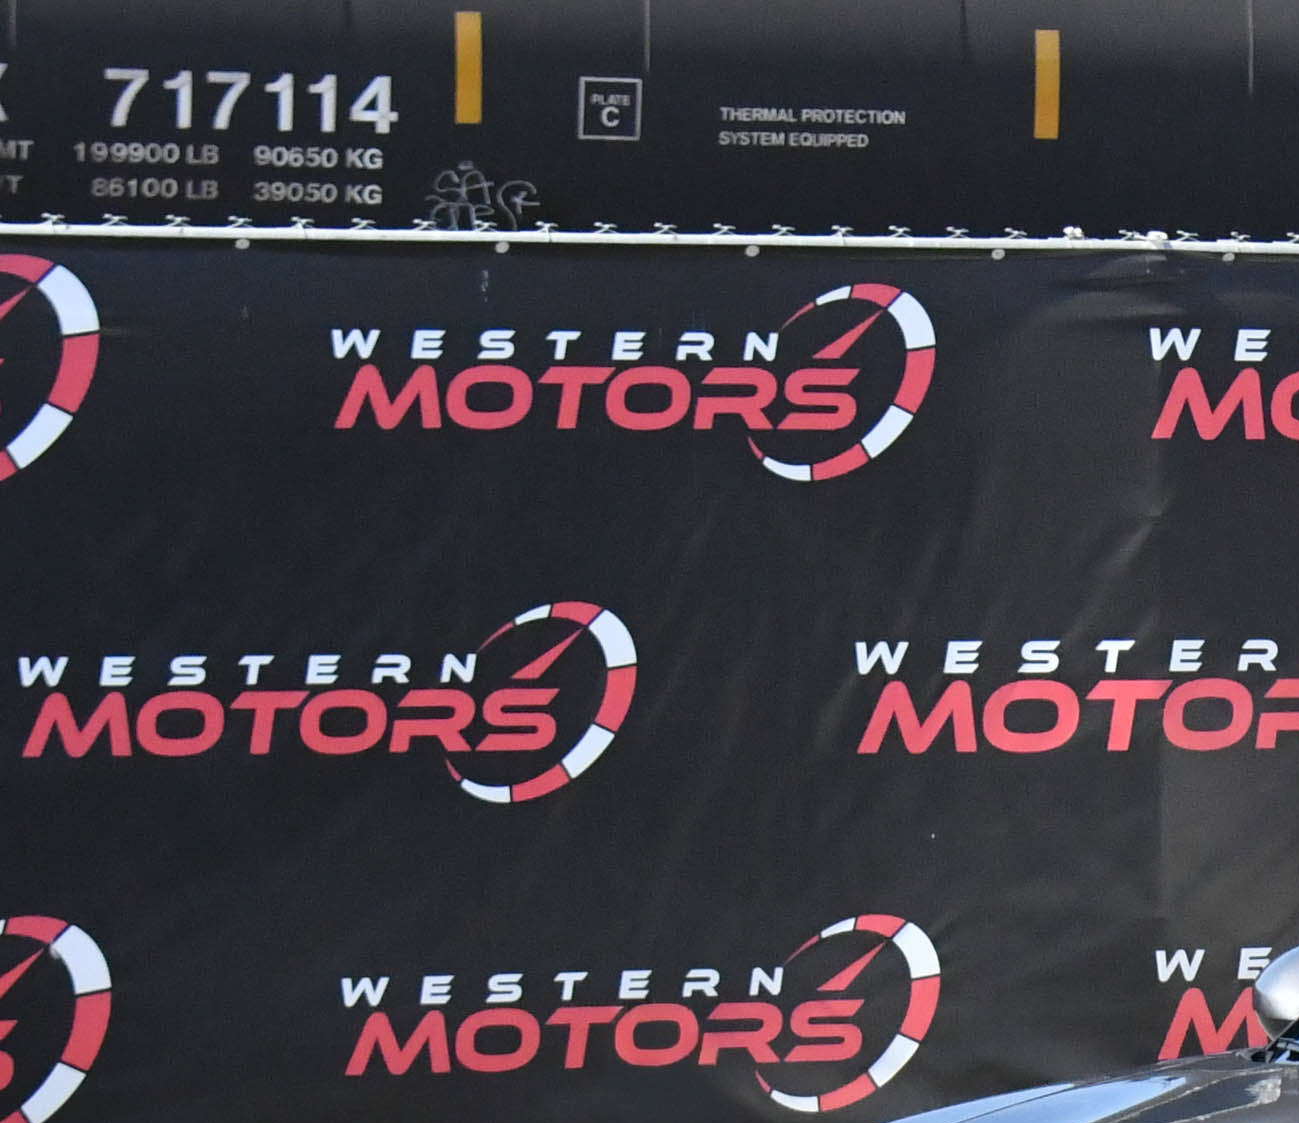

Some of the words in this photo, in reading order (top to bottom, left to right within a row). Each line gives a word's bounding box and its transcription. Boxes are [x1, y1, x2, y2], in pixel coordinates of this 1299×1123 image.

[104, 67, 399, 135] 717114
[591, 93, 631, 106] PLATE
[719, 106, 797, 123] THERMAL
[801, 108, 906, 125] PROTECTION
[600, 106, 620, 128] C
[73, 141, 180, 165] 199900
[185, 142, 220, 165] LB
[253, 145, 339, 169] 90650
[346, 147, 384, 170] KG
[718, 130, 785, 146] SYSTEM
[789, 132, 870, 148] EQUIPPED
[90, 176, 178, 199] 86100
[185, 176, 219, 200] LB
[253, 179, 338, 204] 39050
[346, 183, 383, 205] KG
[331, 329, 779, 362] WESTERN
[335, 364, 861, 430] MOTORS
[19, 653, 477, 687] WESTERN
[22, 689, 560, 758] MOTORS
[341, 966, 784, 1007] WESTERN
[345, 999, 866, 1077] MOTORS
